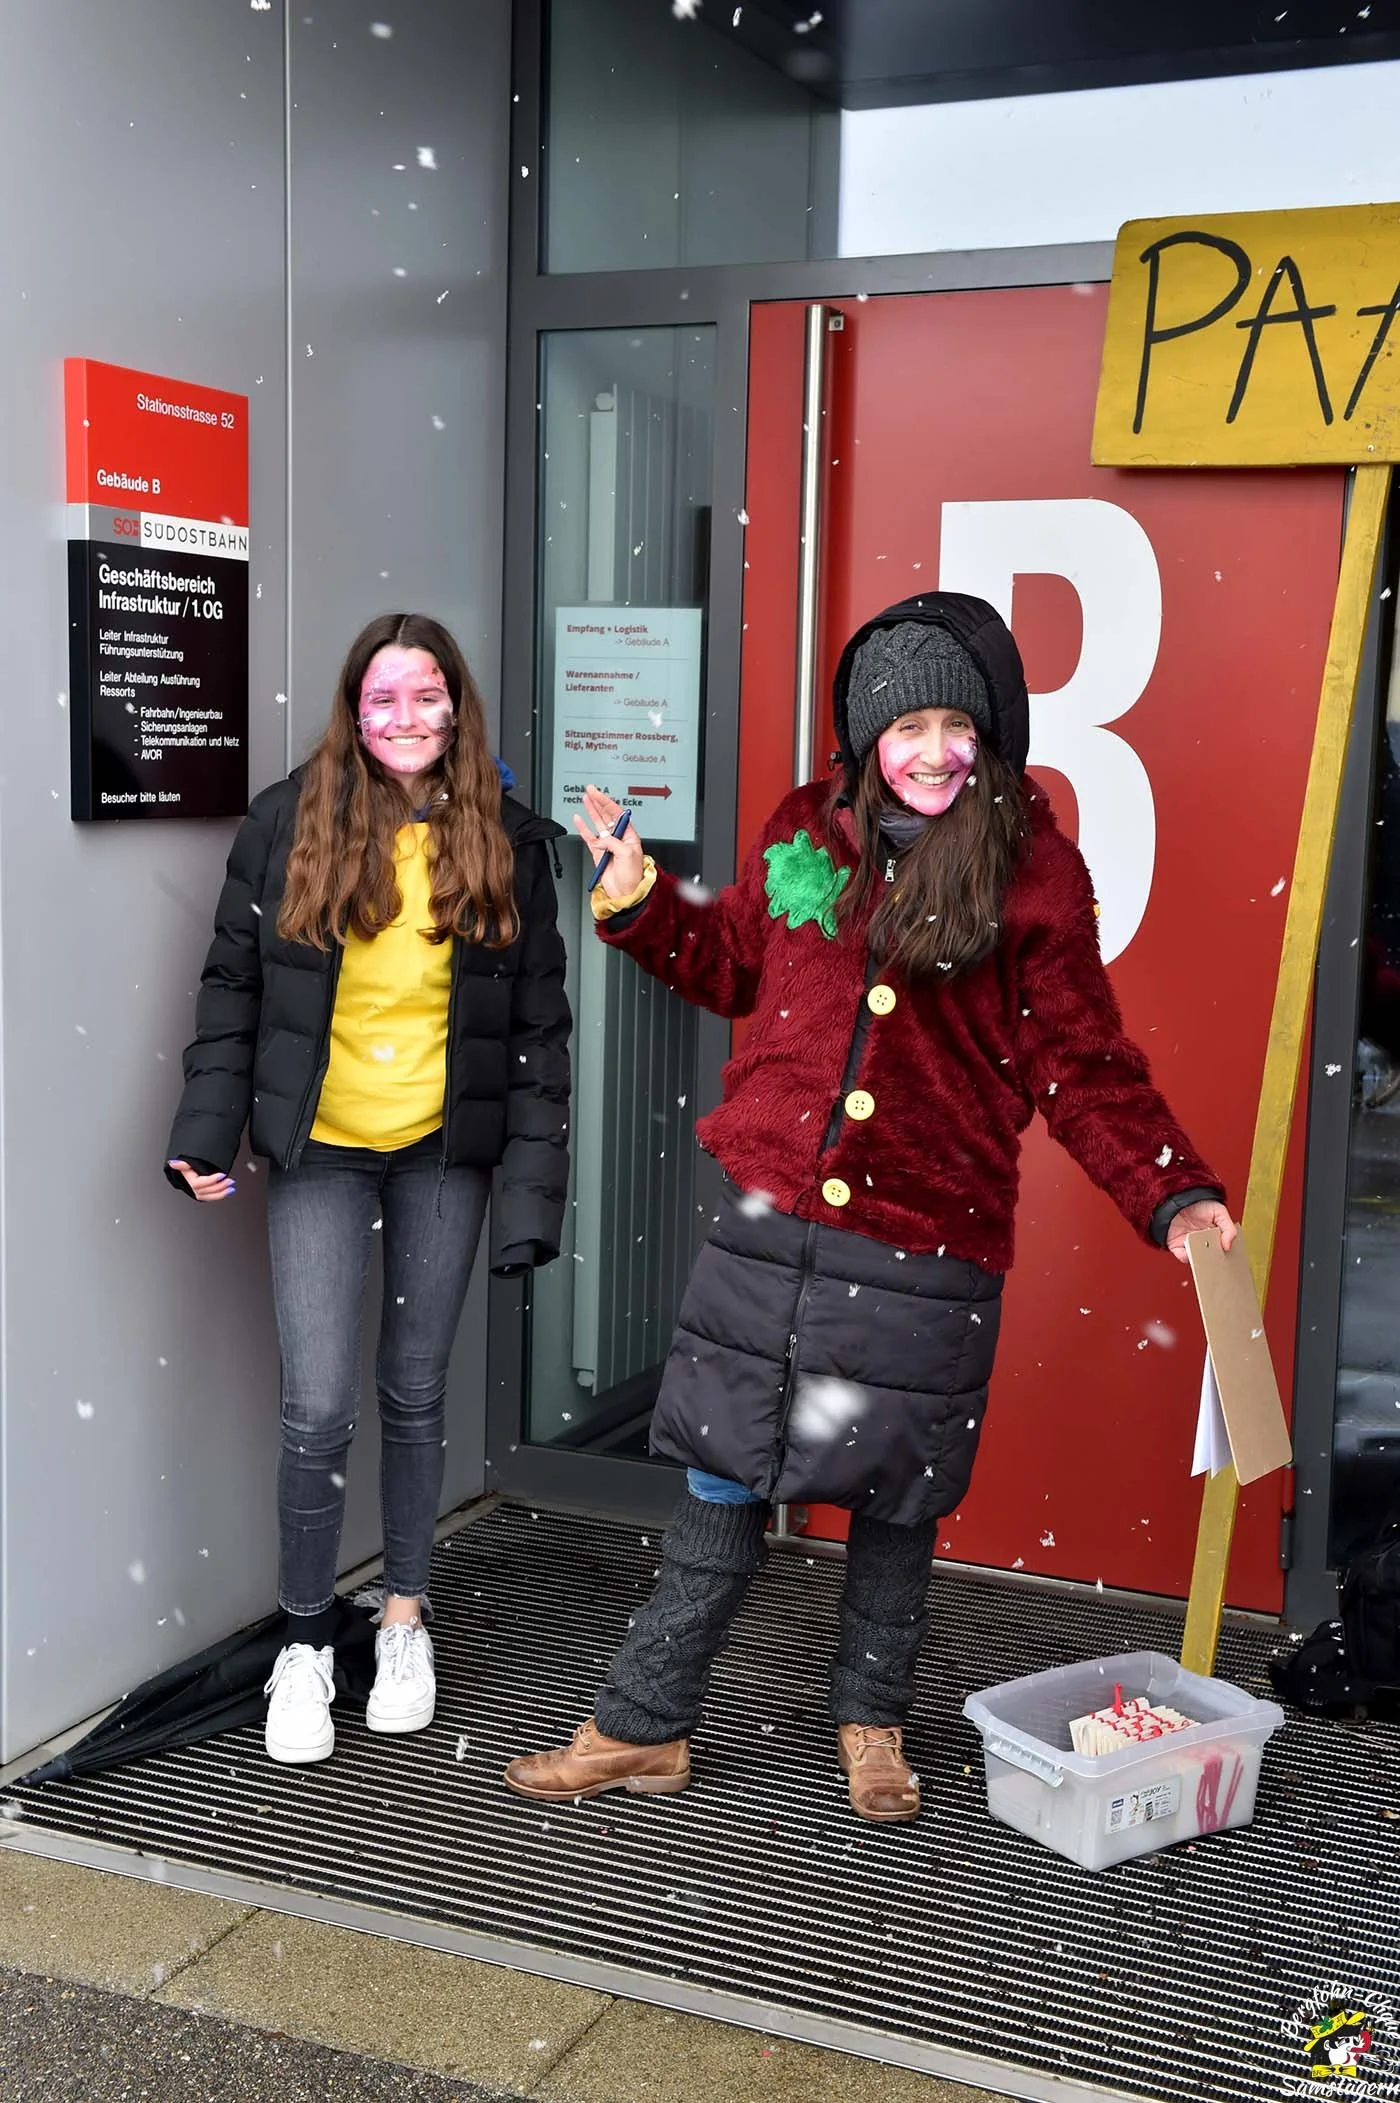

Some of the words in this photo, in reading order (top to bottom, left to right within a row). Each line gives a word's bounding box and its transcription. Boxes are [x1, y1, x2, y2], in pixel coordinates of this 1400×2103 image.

[136, 393, 217, 426] Stationsstrasse
[220, 412, 235, 429] 52
[97, 469, 148, 492] Gebäude
[152, 480, 161, 494] B
[144, 522, 248, 552] SÜDOSTBAHN
[99, 564, 216, 594] Geschäftsbereich
[99, 590, 180, 616] Infrastruktur
[567, 624, 605, 634] Empfang
[614, 624, 648, 634] Logistik
[100, 628, 121, 641] Leiter
[124, 630, 168, 644] Infrastruktur
[625, 638, 660, 646] Gebäude
[662, 638, 670, 646] A
[100, 643, 184, 662] Führungsunterstützung
[100, 670, 122, 682] Leiter
[124, 671, 158, 686] Abteilung
[160, 673, 200, 688] Ausführung
[566, 670, 633, 680] Warenannahme
[100, 686, 136, 698] Ressorts
[566, 684, 614, 692] Lieferanten
[624, 698, 659, 708] Gebäude
[661, 699, 668, 708] A
[140, 706, 223, 721] Fahrbahn/Ingenieurbau
[140, 721, 208, 735] Sicherungsanlagen
[140, 736, 207, 746] Telekommunikation
[208, 736, 222, 746] und
[224, 736, 240, 746] Netz
[565, 730, 633, 740] Sitzungszimmer
[635, 732, 678, 743] Rossberg,
[564, 742, 584, 751] Rigi,
[586, 742, 618, 751] Mythen
[140, 750, 162, 760] AVOR
[622, 754, 658, 763] Gebäude
[660, 755, 666, 763] A
[604, 786, 610, 794] A
[101, 792, 138, 804] Besucher
[140, 792, 156, 802] bitte
[158, 792, 180, 802] läuten
[622, 798, 643, 806] Ecke
